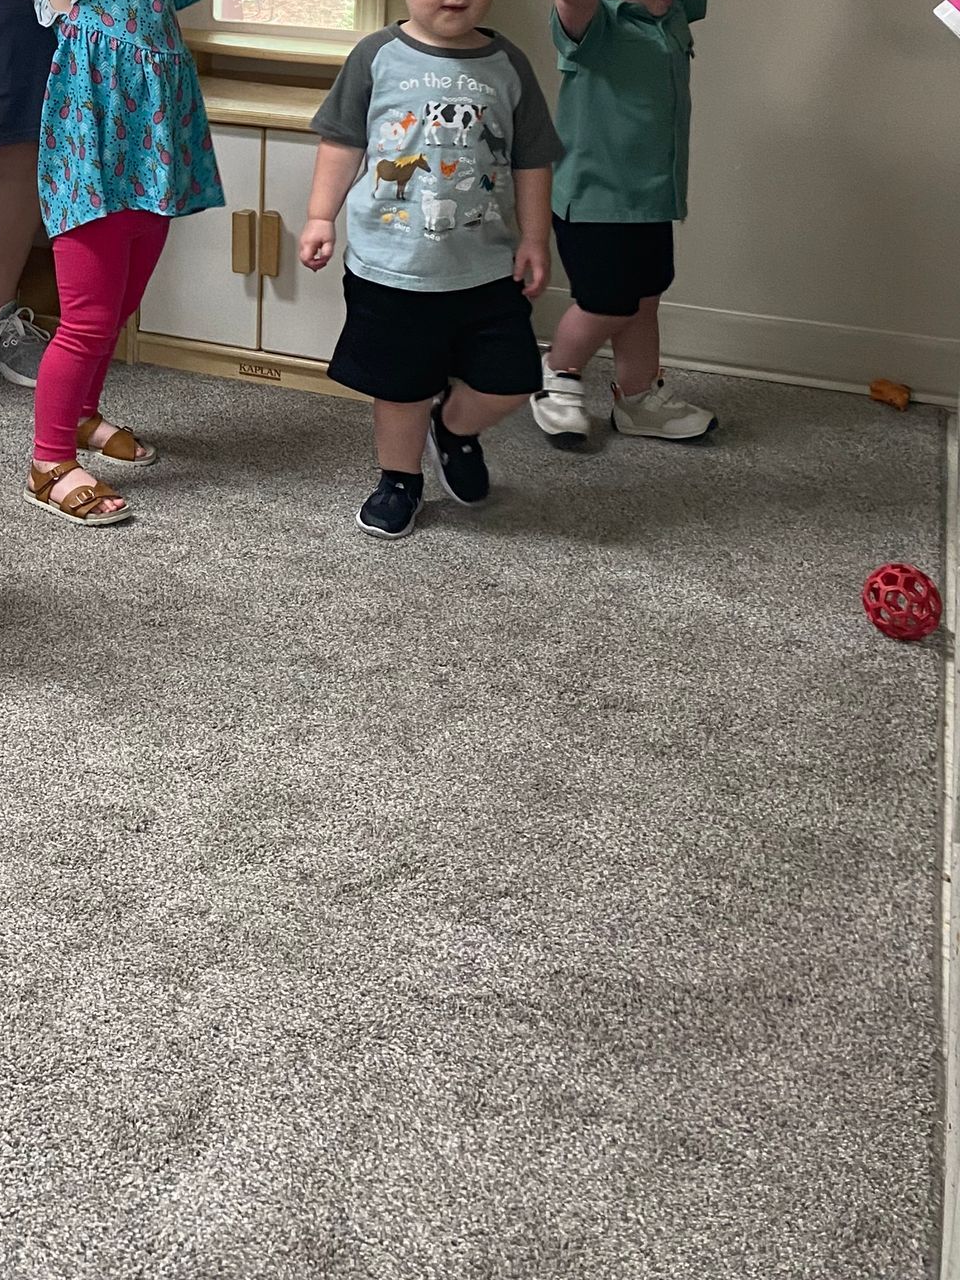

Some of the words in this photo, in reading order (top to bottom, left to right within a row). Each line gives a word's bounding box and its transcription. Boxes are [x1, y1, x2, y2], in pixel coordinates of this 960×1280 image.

[400, 78, 419, 91] on
[420, 71, 452, 89] the
[456, 74, 497, 97] farm
[239, 363, 281, 378] KAPLAN
